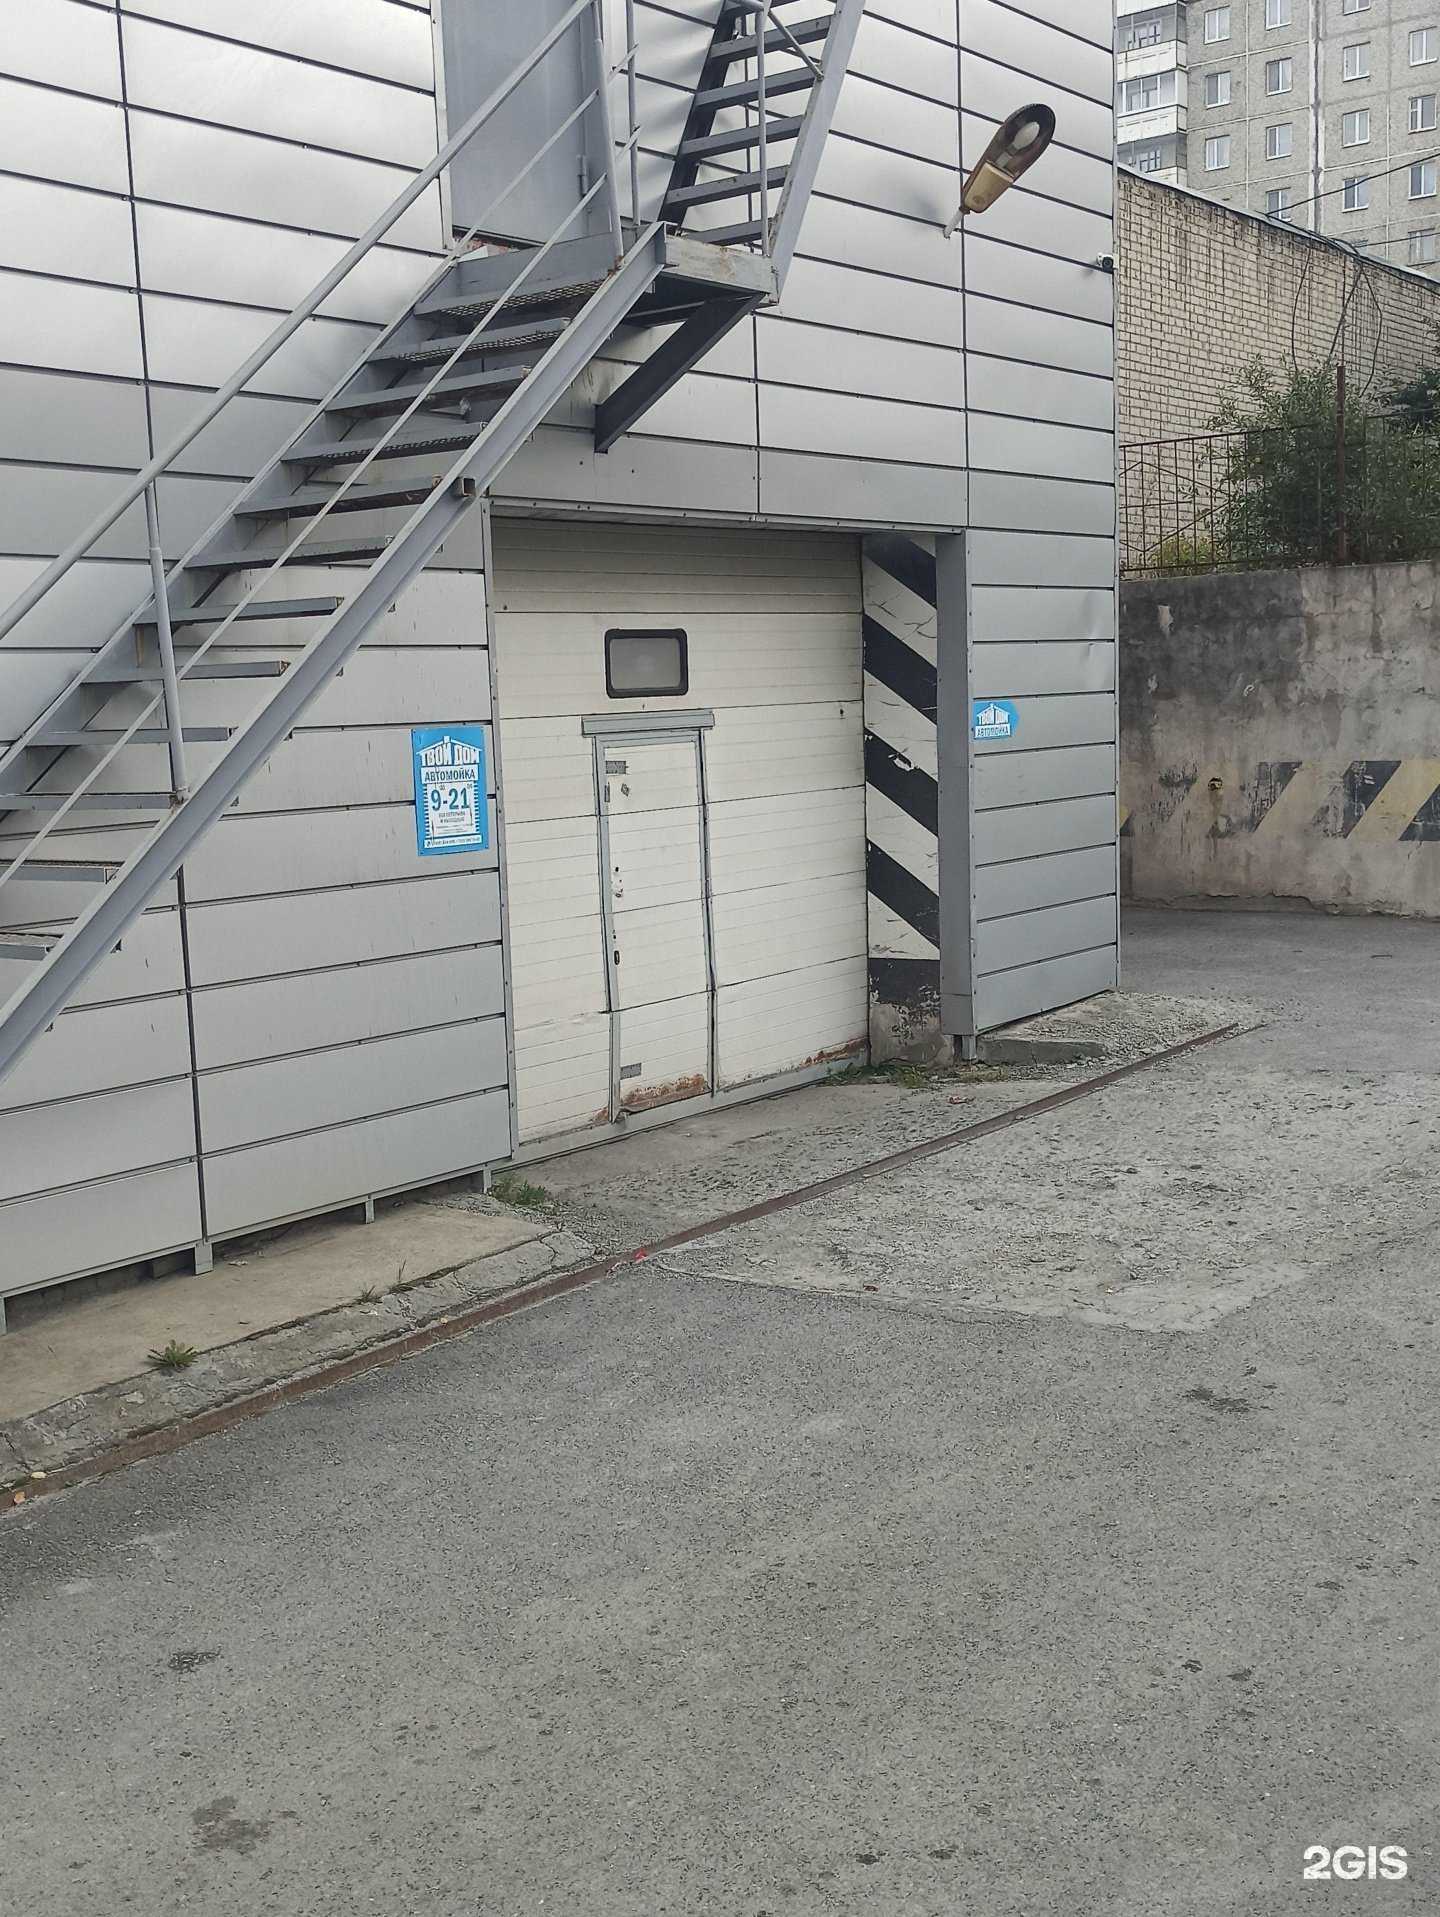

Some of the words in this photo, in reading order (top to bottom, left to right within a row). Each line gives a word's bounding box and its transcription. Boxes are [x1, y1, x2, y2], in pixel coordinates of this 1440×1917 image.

[421, 741, 453, 766] ТВОЙ
[454, 744, 480, 765] ДОМ
[424, 768, 476, 781] АВТОМОЙКА
